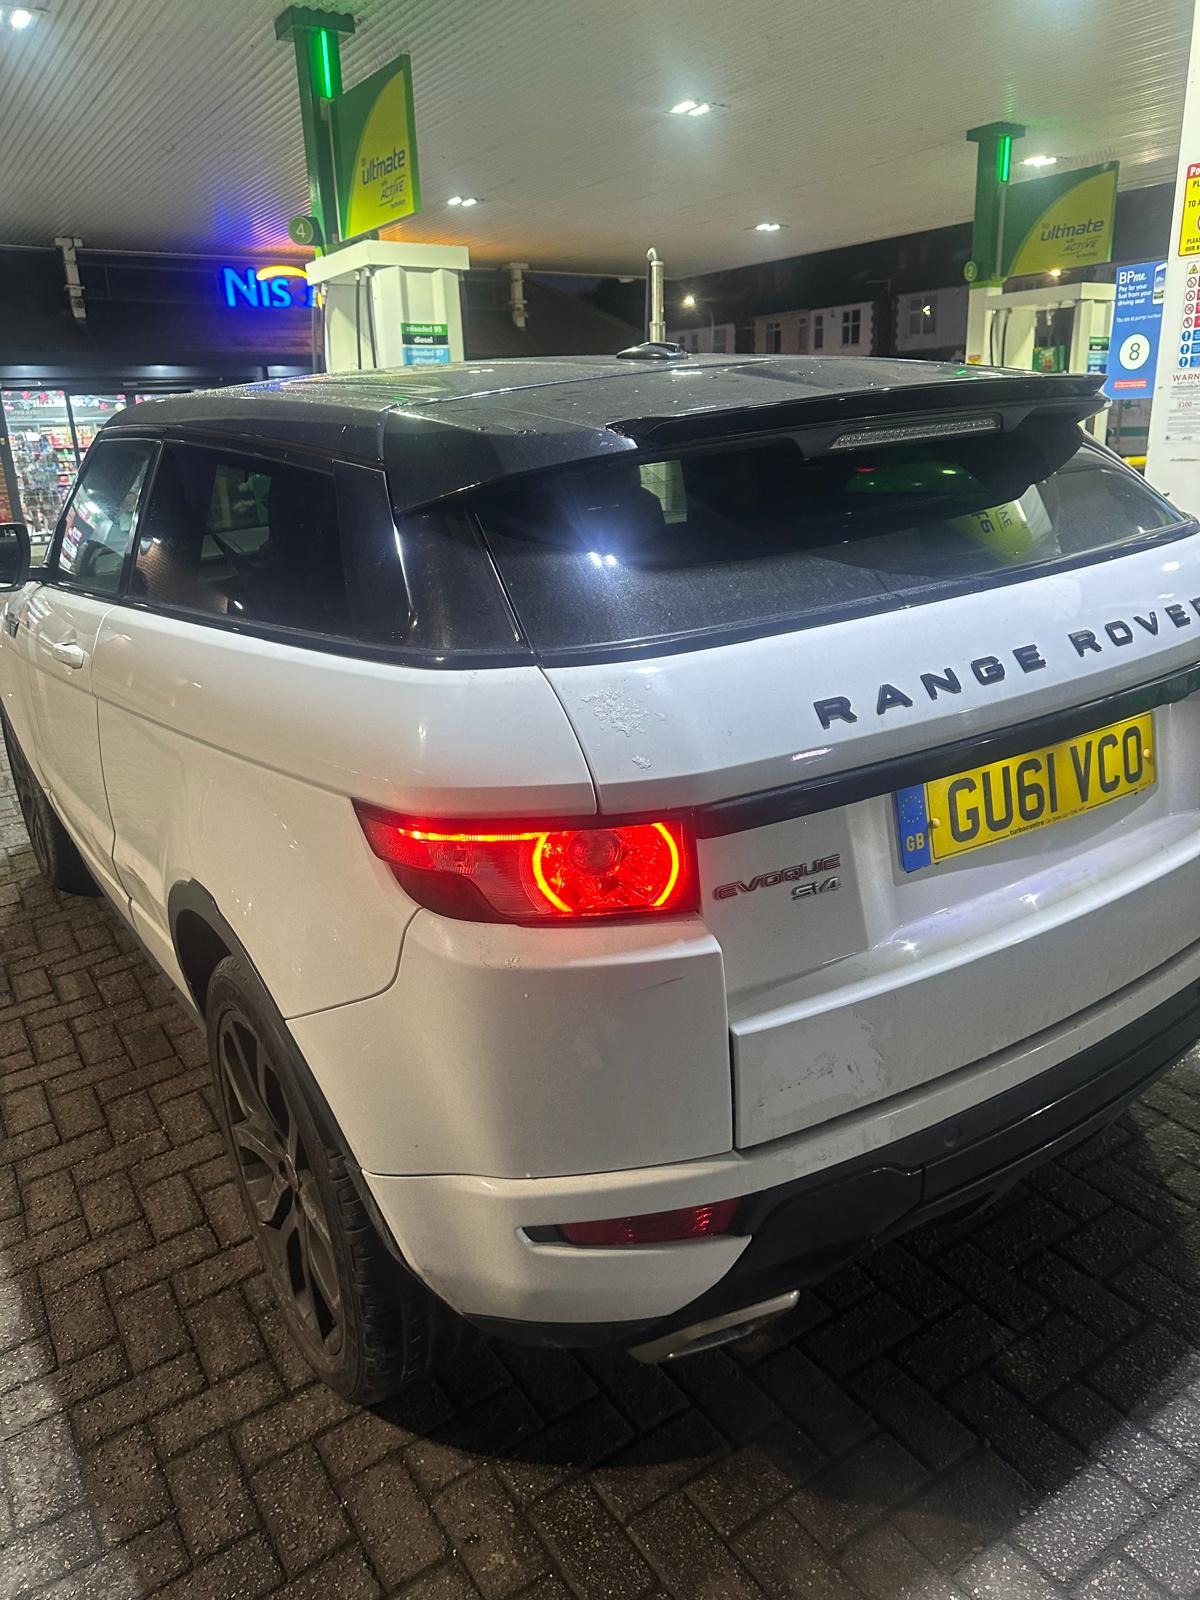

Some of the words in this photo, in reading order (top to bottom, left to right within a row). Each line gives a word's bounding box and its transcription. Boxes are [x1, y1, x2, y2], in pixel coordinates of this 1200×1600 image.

[362, 147, 405, 185] ultimate
[296, 223, 306, 239] 4
[1041, 218, 1104, 242] ultimate
[968, 265, 973, 277] 2
[1119, 271, 1147, 285] BPme
[1118, 285, 1128, 293] Pay
[414, 336, 434, 344] diesel
[1129, 342, 1141, 361] 8
[813, 644, 1047, 729] RANGE
[947, 752, 1058, 843] GU61
[1070, 725, 1143, 803] VCO
[906, 832, 925, 852] GB
[712, 853, 841, 900] EVOQUE
